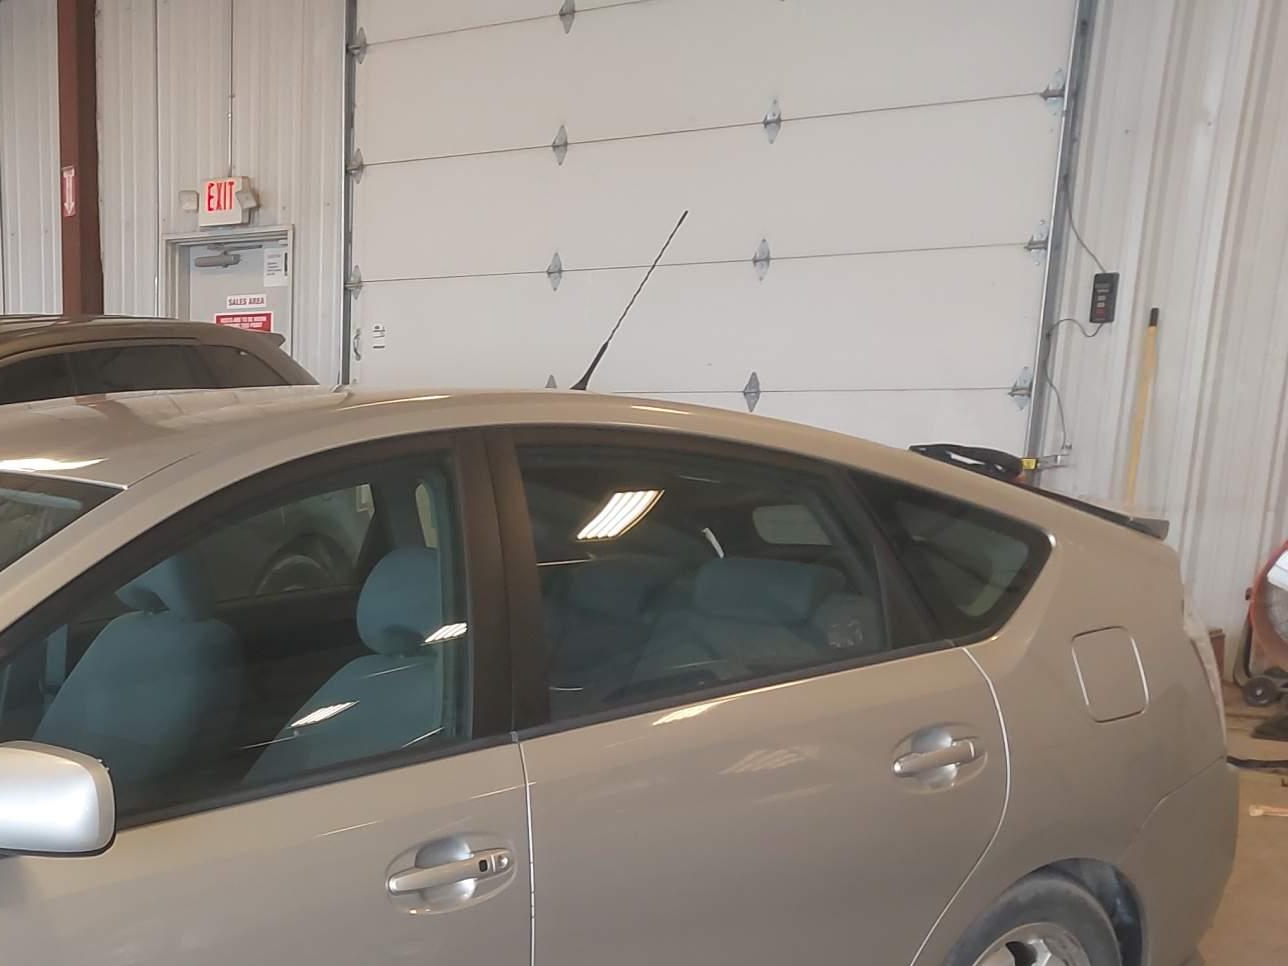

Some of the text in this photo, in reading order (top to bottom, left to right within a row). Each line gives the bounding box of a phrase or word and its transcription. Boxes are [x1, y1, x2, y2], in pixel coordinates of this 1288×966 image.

[207, 182, 235, 212] EXIT
[228, 297, 265, 306] SALES AREA
